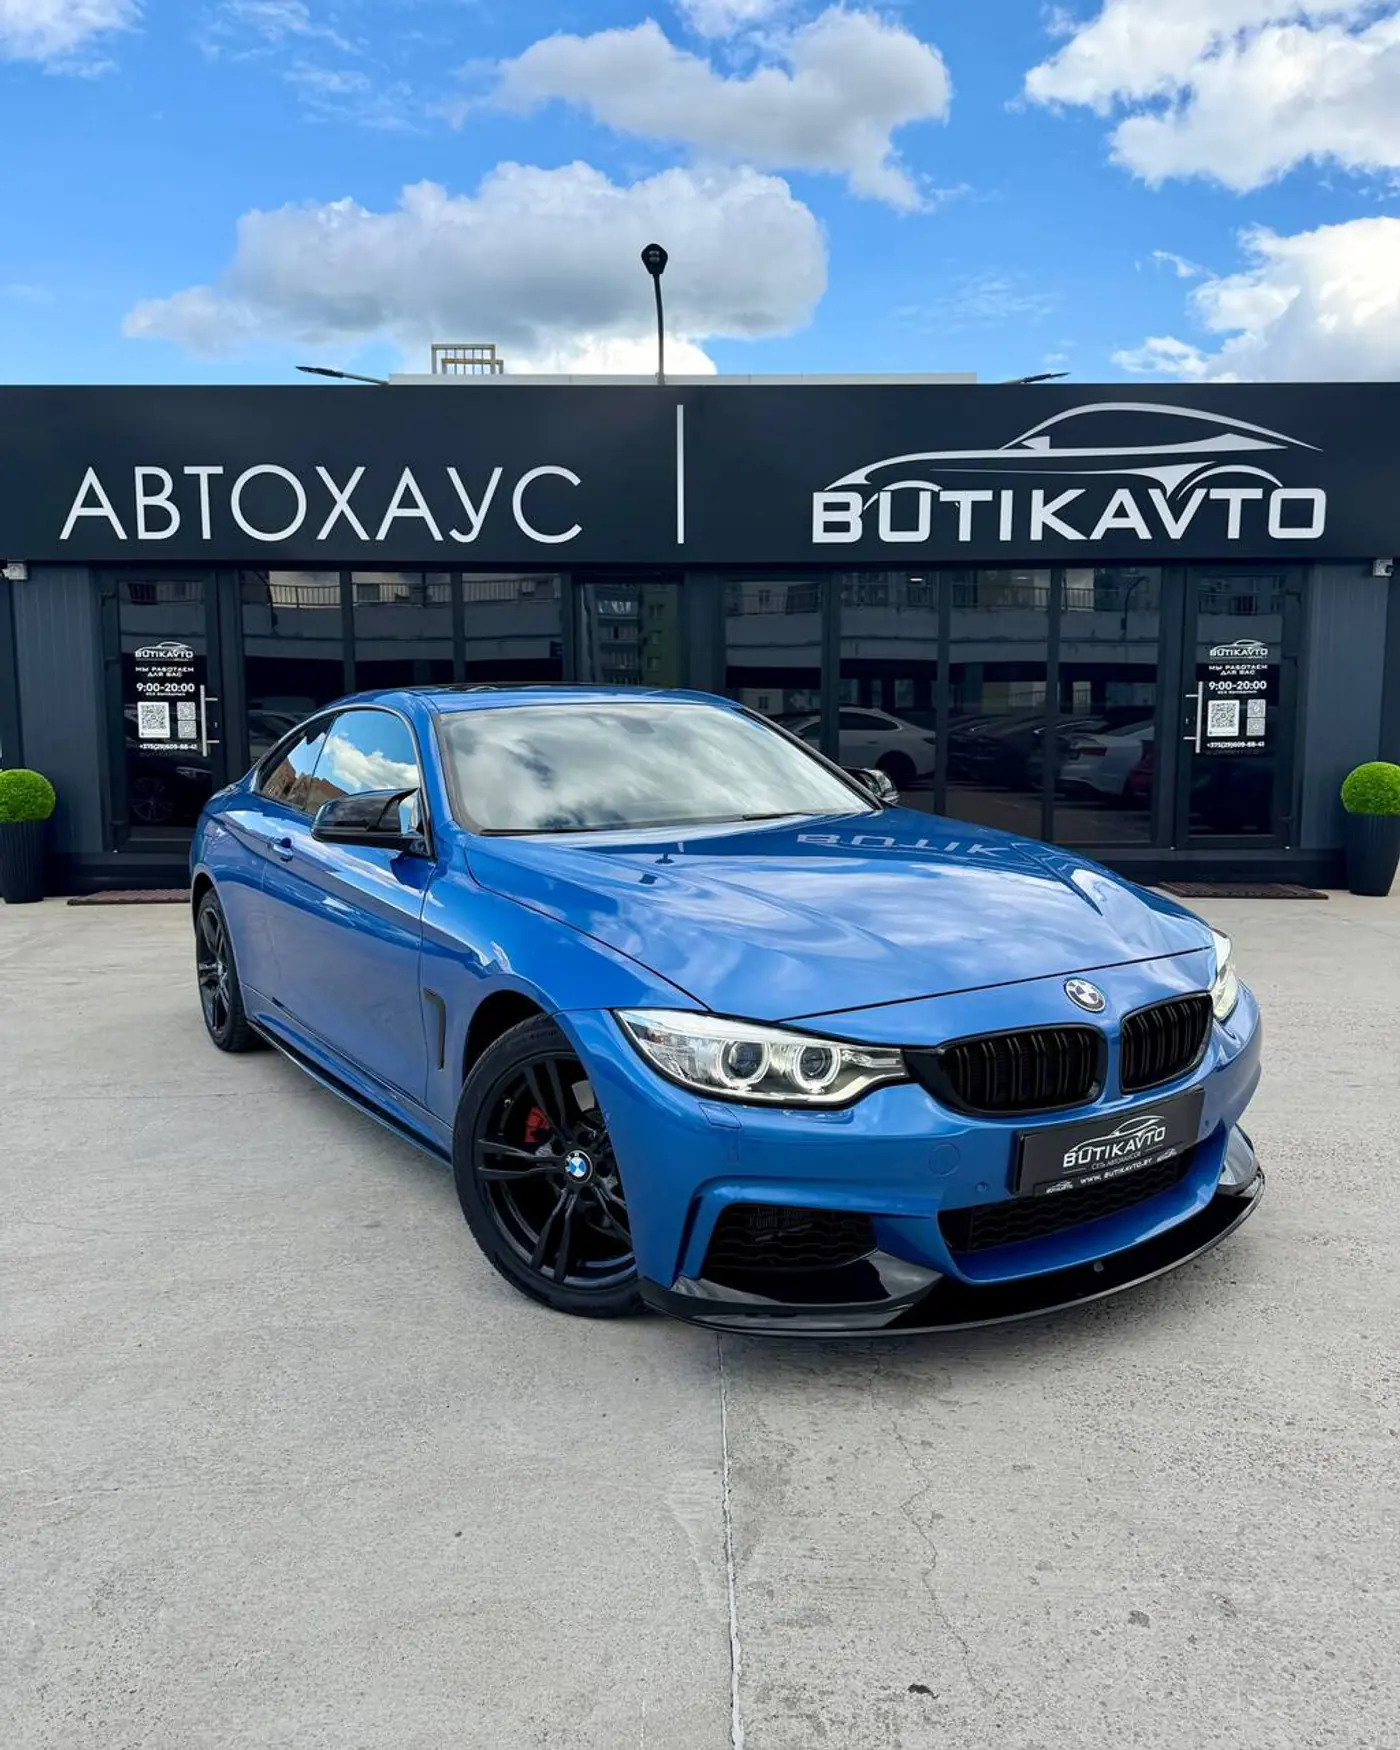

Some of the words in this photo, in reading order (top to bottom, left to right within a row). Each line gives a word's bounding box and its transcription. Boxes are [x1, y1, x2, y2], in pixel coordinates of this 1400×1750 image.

[60, 465, 582, 543] АВТОХАУС
[812, 487, 1327, 544] BUTIKAVTO
[135, 650, 194, 658] BUTIKAVTO
[1209, 648, 1269, 657] BUTIKAVTO
[136, 683, 196, 693] 9:00-20:00
[1208, 681, 1268, 691] 9:00-20:00
[1062, 1126, 1166, 1168] BUTIKAVTO
